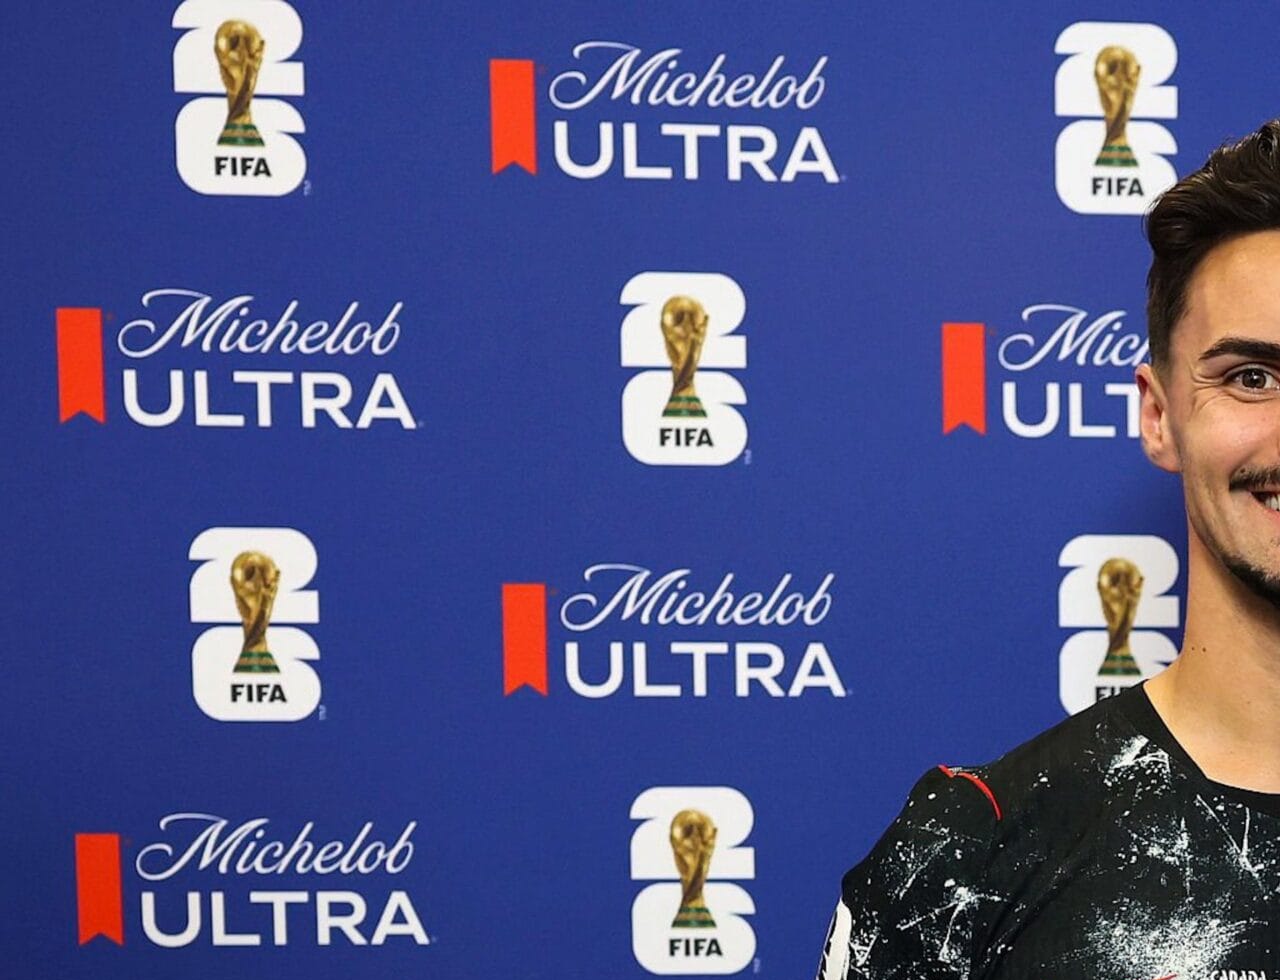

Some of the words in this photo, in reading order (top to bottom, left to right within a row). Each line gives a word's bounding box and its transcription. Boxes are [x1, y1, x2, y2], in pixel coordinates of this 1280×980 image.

[550, 42, 827, 109] Michelob
[214, 156, 272, 178] FIFA
[555, 121, 839, 183] ULTRA
[1092, 177, 1144, 197] FIFA
[118, 289, 402, 357] Michelob
[124, 370, 416, 429] ULTRA
[1002, 382, 1142, 438] ULT
[659, 427, 714, 447] FIFA
[561, 565, 834, 630] Michelob
[230, 683, 288, 703] FIFA
[566, 642, 845, 698] ULTRA
[136, 814, 416, 880] Michelob
[142, 891, 429, 947] ULTRA
[669, 938, 723, 957] FIFA
